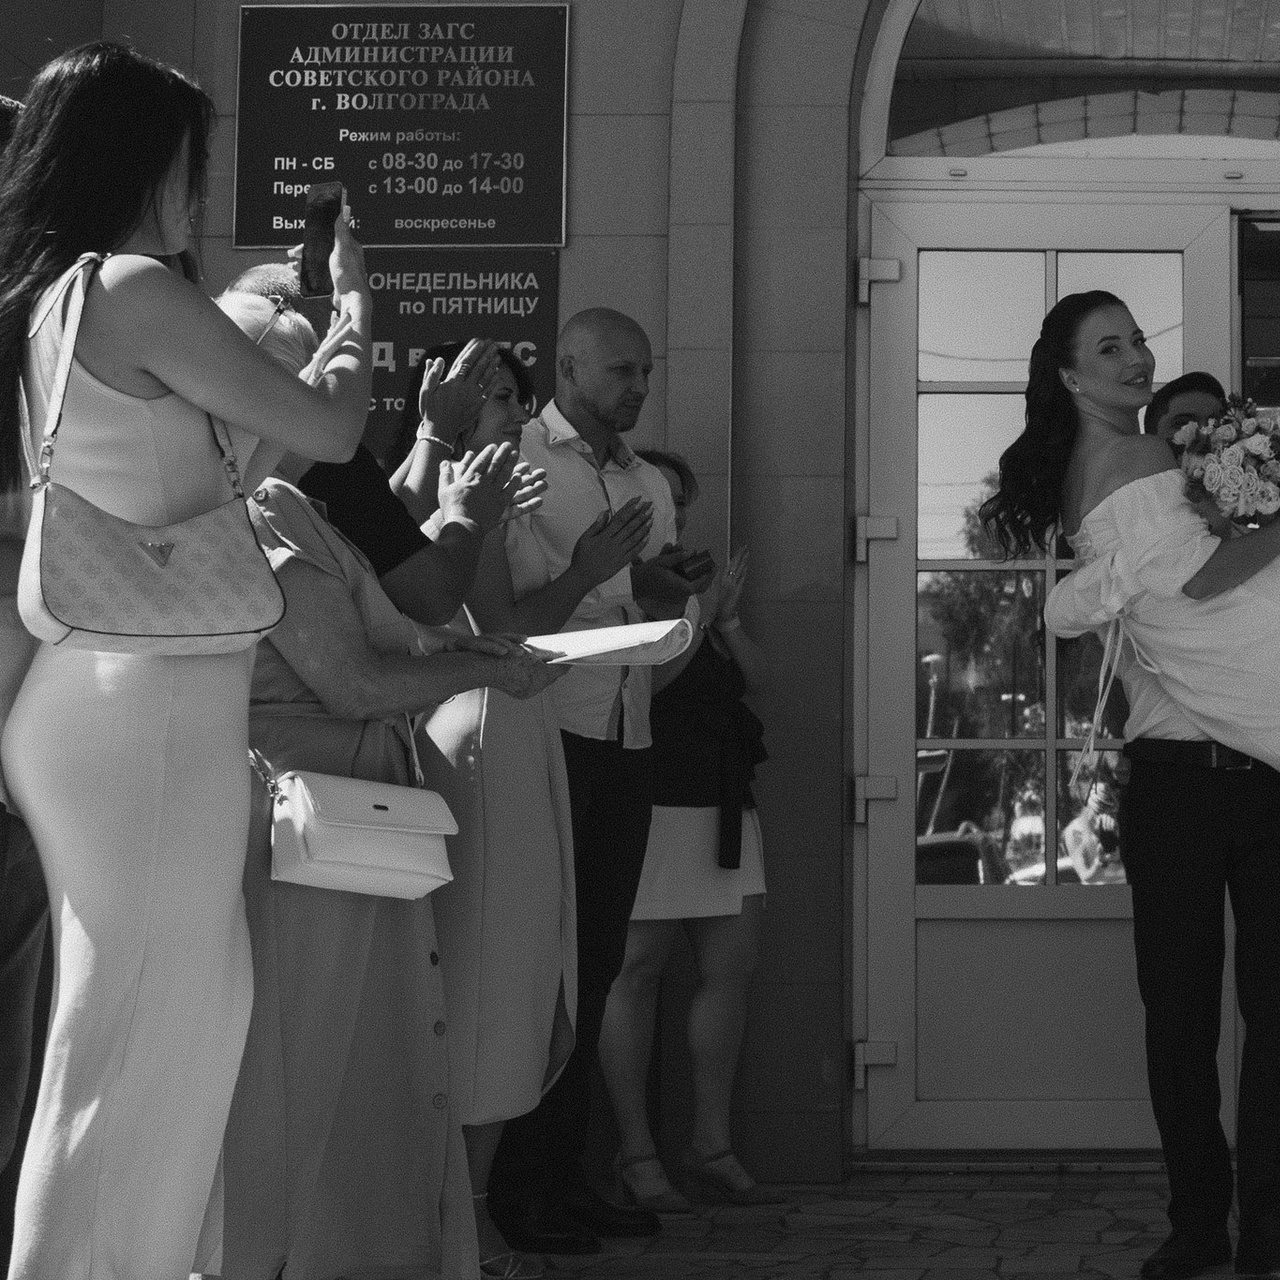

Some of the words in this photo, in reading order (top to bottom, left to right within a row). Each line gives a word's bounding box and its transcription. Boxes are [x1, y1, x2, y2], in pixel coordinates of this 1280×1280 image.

[332, 23, 409, 42] ОТДЕЛ
[419, 23, 474, 39] ЗАГС
[290, 47, 513, 67] АДМИНИСТРАЦИИ
[269, 70, 427, 87] СОВЕТСКОГО
[438, 65, 534, 86] РАЙОНА
[312, 98, 326, 110] г.
[336, 93, 489, 111] ВОЛГОГРАДА
[339, 129, 390, 141] Режим
[396, 129, 460, 144] работы:
[274, 157, 296, 170] ПН
[312, 157, 334, 170] СБ
[368, 160, 377, 169] с
[382, 153, 438, 169] 08-30
[443, 160, 463, 171] до
[470, 152, 524, 170] 17-30
[369, 184, 377, 194] с
[384, 177, 438, 194] 13-00
[442, 184, 463, 195] до
[469, 177, 523, 194] 14-00
[395, 219, 496, 231] воскресенье
[369, 272, 540, 292] ОНЕДЕЛЬНИКА
[400, 301, 425, 314] по
[433, 297, 538, 317] ПЯТНИЦУ
